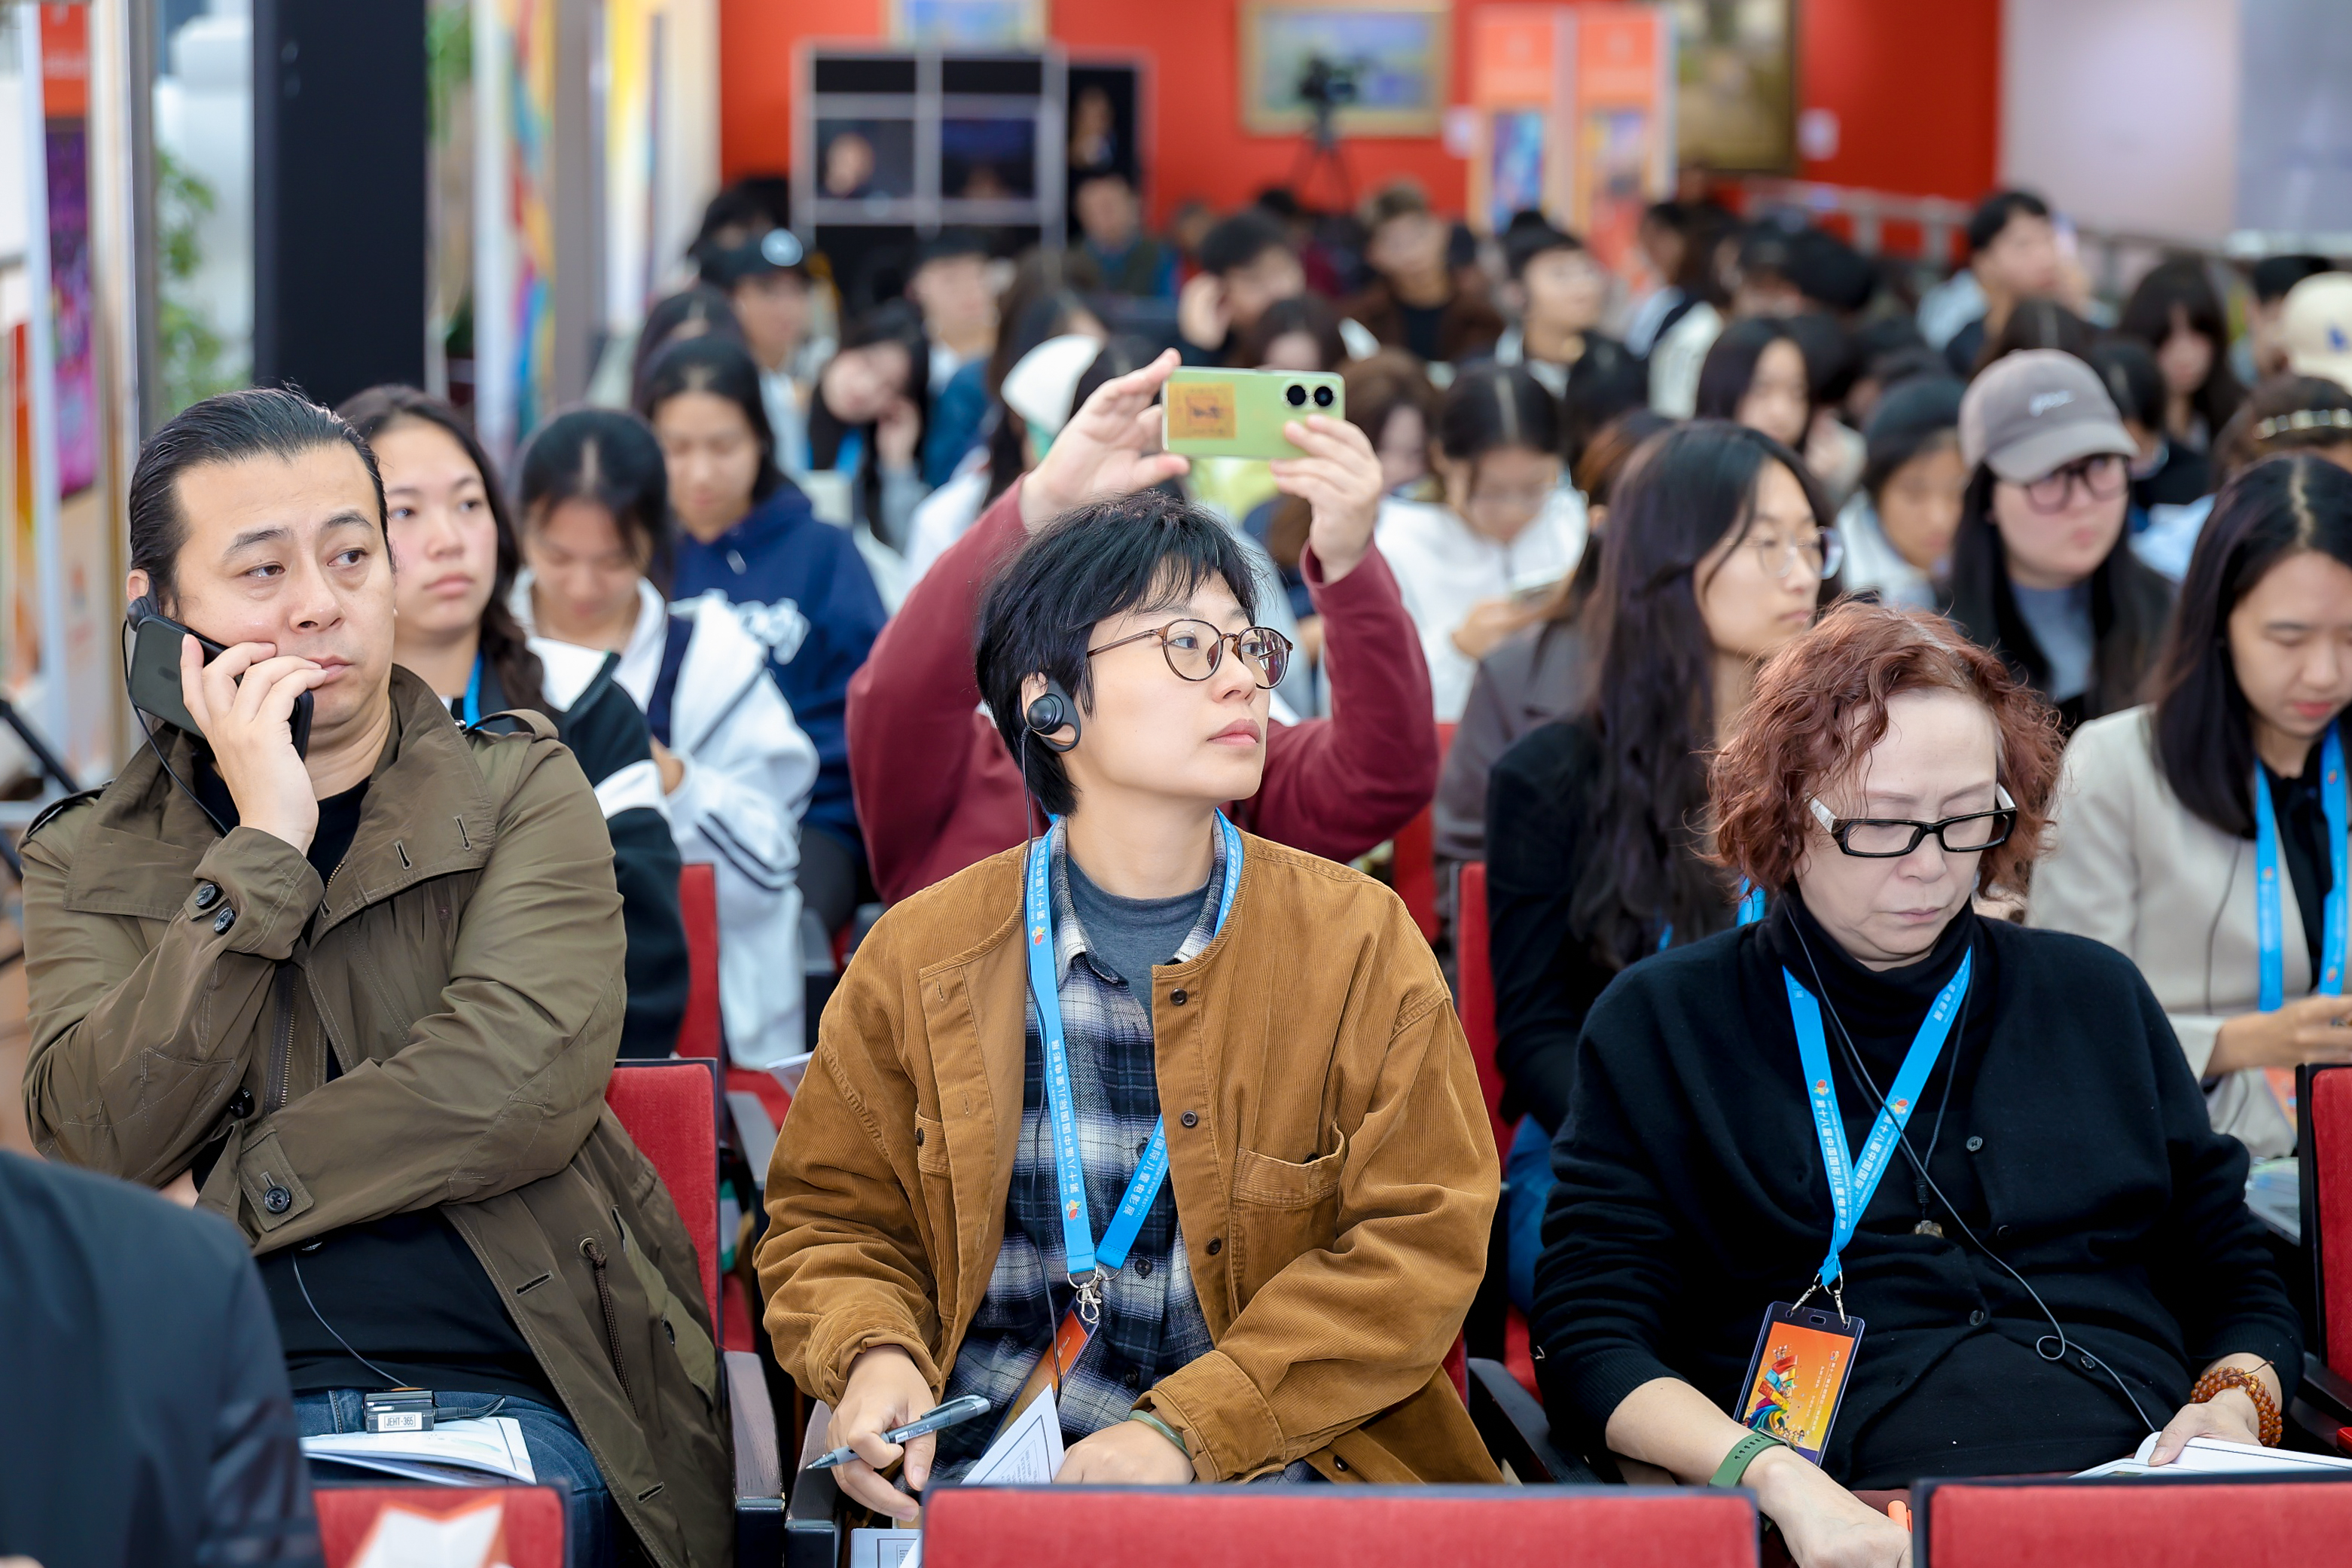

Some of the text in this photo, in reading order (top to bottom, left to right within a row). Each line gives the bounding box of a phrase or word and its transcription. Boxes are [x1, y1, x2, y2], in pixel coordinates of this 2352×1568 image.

[1051, 1039, 1079, 1194] 第十八届中国国际儿童电影展
[1815, 1100, 1847, 1230] 第十八届中国国际儿童电影展
[386, 1417, 413, 1426] JEHT-365
